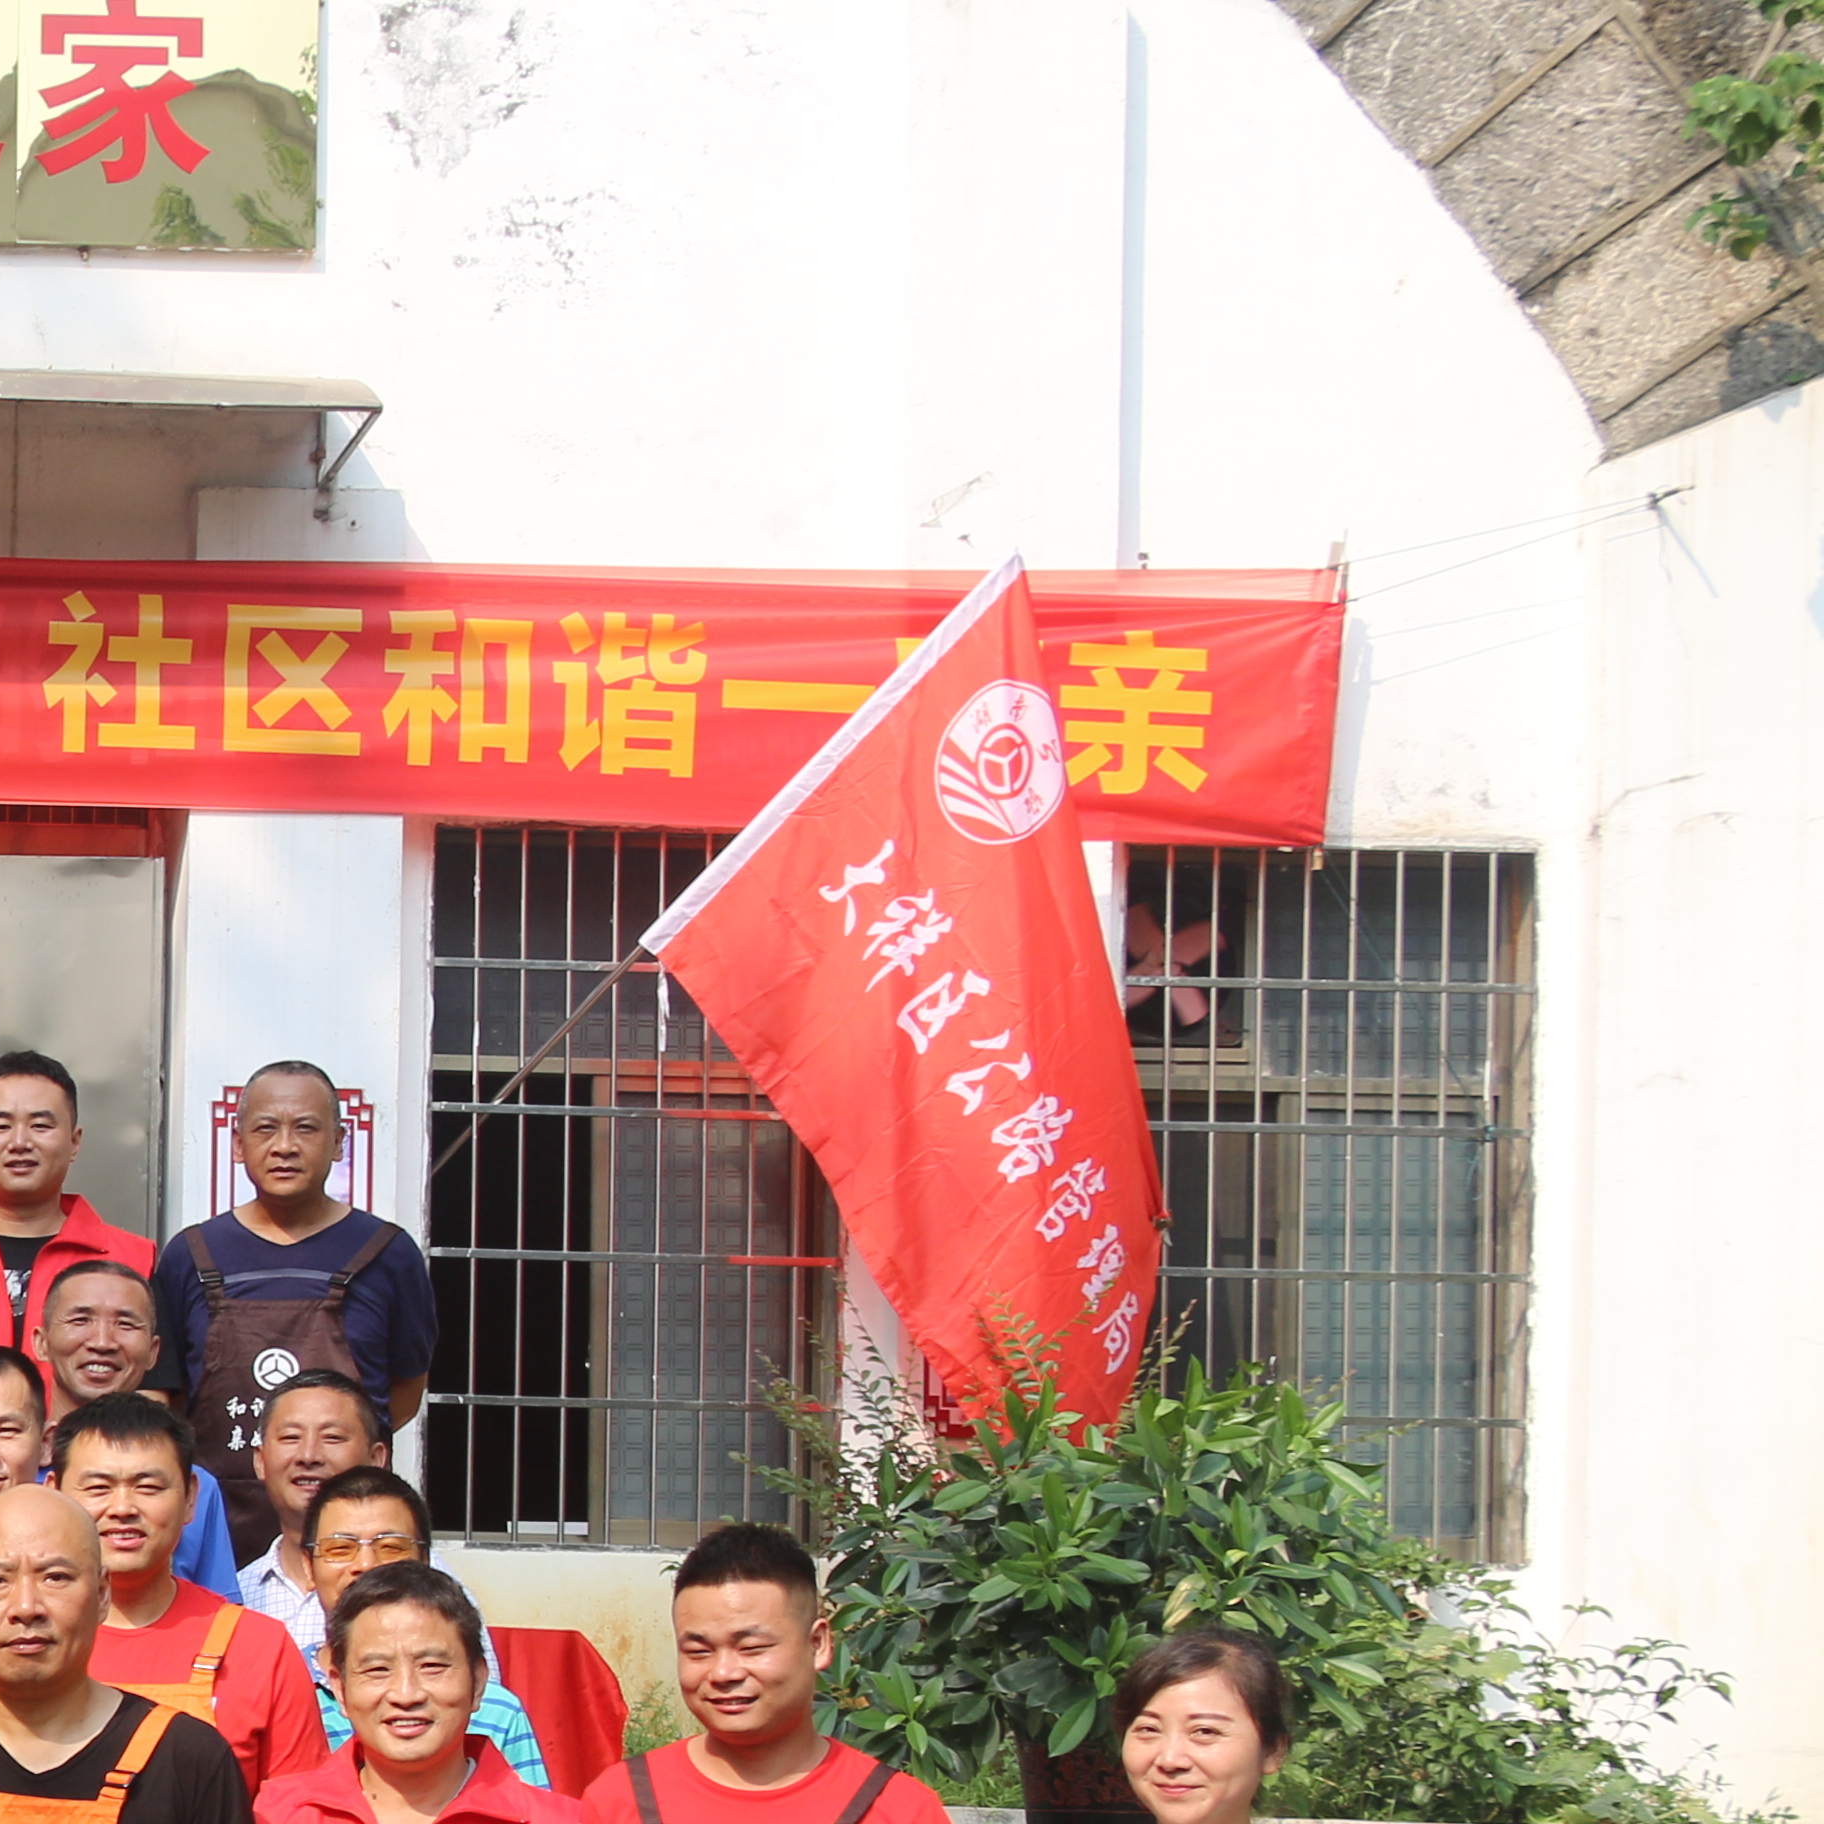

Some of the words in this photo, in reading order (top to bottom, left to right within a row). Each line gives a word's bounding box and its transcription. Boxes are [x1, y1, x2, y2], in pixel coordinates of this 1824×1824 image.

[41, 588, 1215, 796] 社区和谐一亲
[818, 838, 1140, 1375] 大祥区公路管理局
